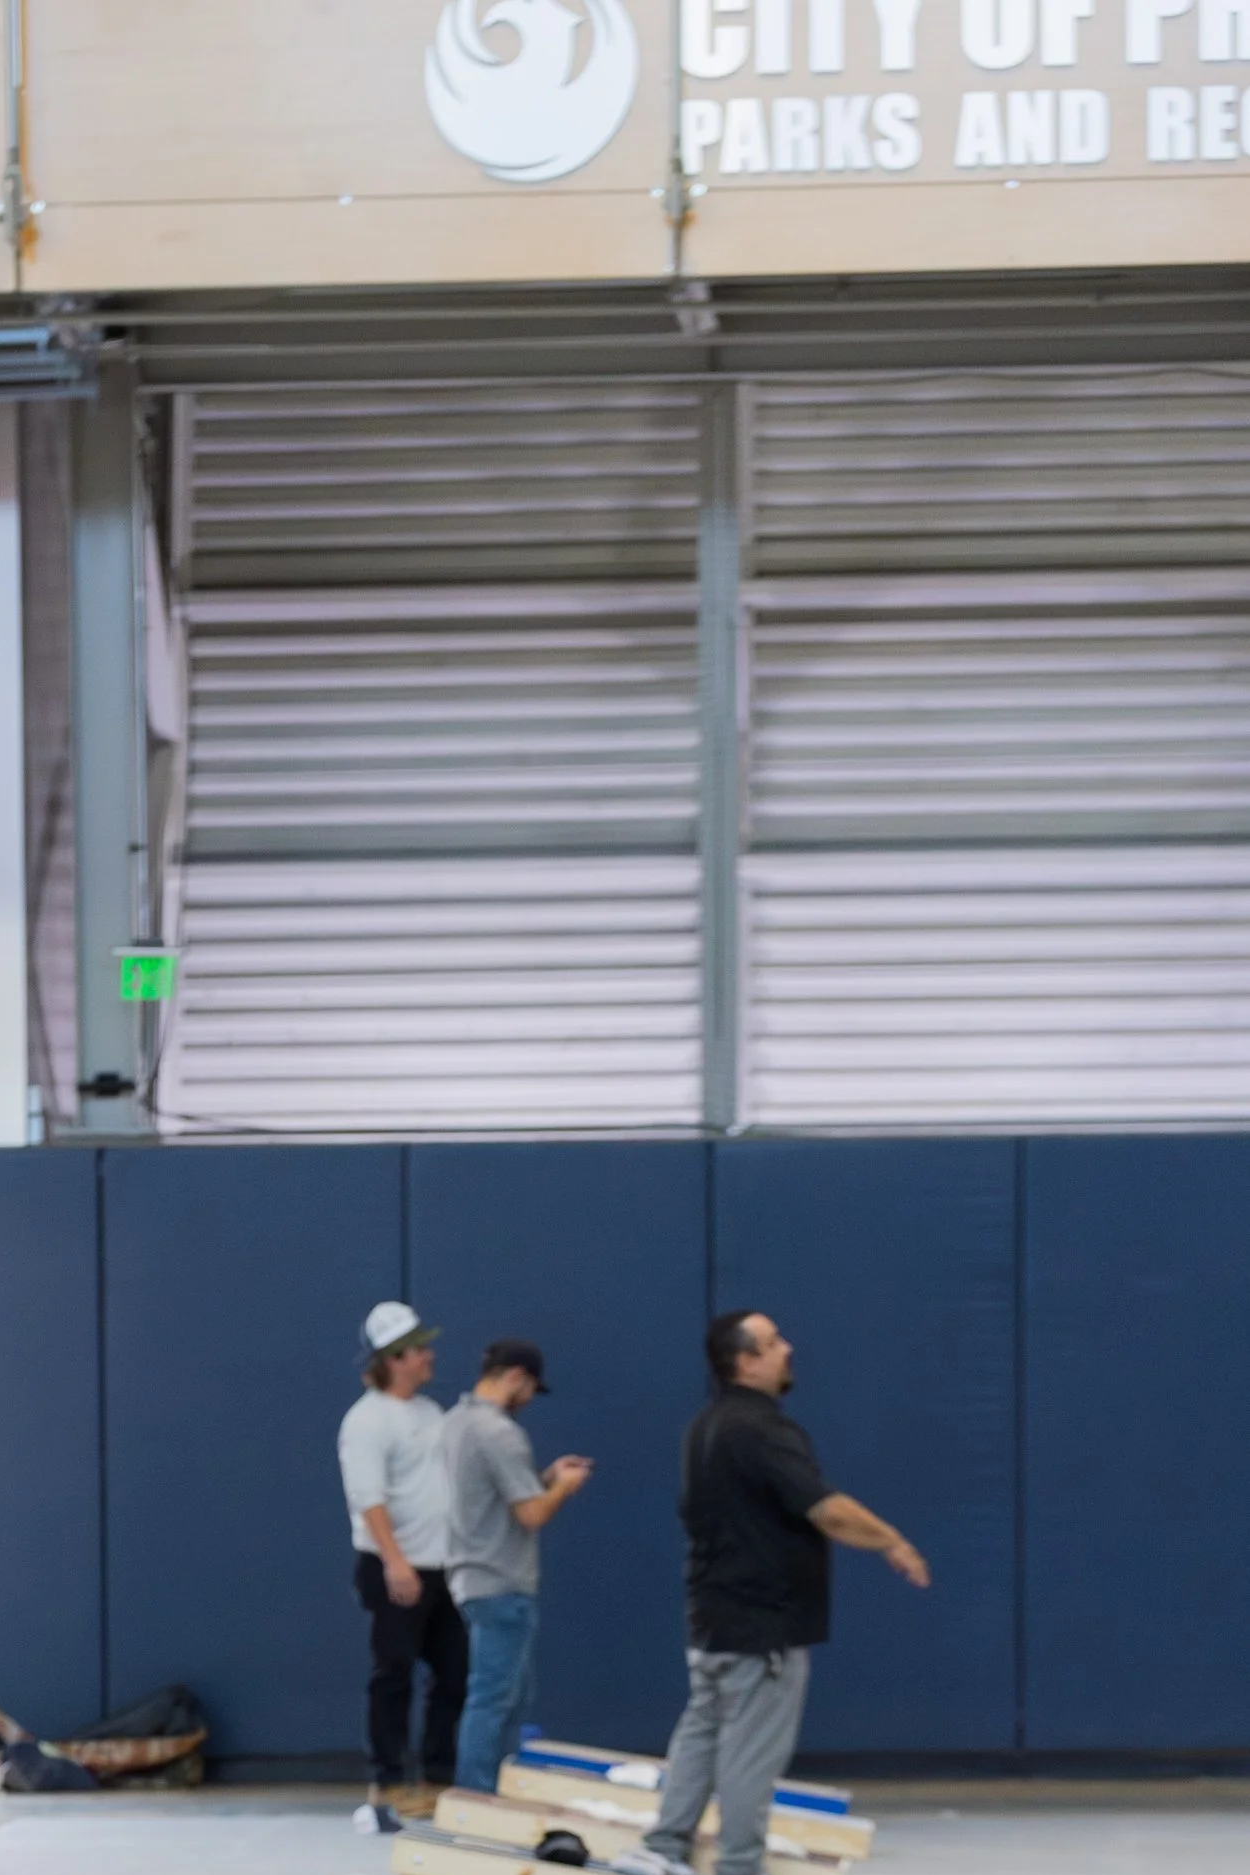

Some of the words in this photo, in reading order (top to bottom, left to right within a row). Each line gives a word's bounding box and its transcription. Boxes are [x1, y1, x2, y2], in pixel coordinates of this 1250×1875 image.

[680, 0, 920, 79] CITY
[681, 92, 922, 175] PARKS
[955, 89, 1108, 168] AND
[1147, 85, 1250, 162] RE
